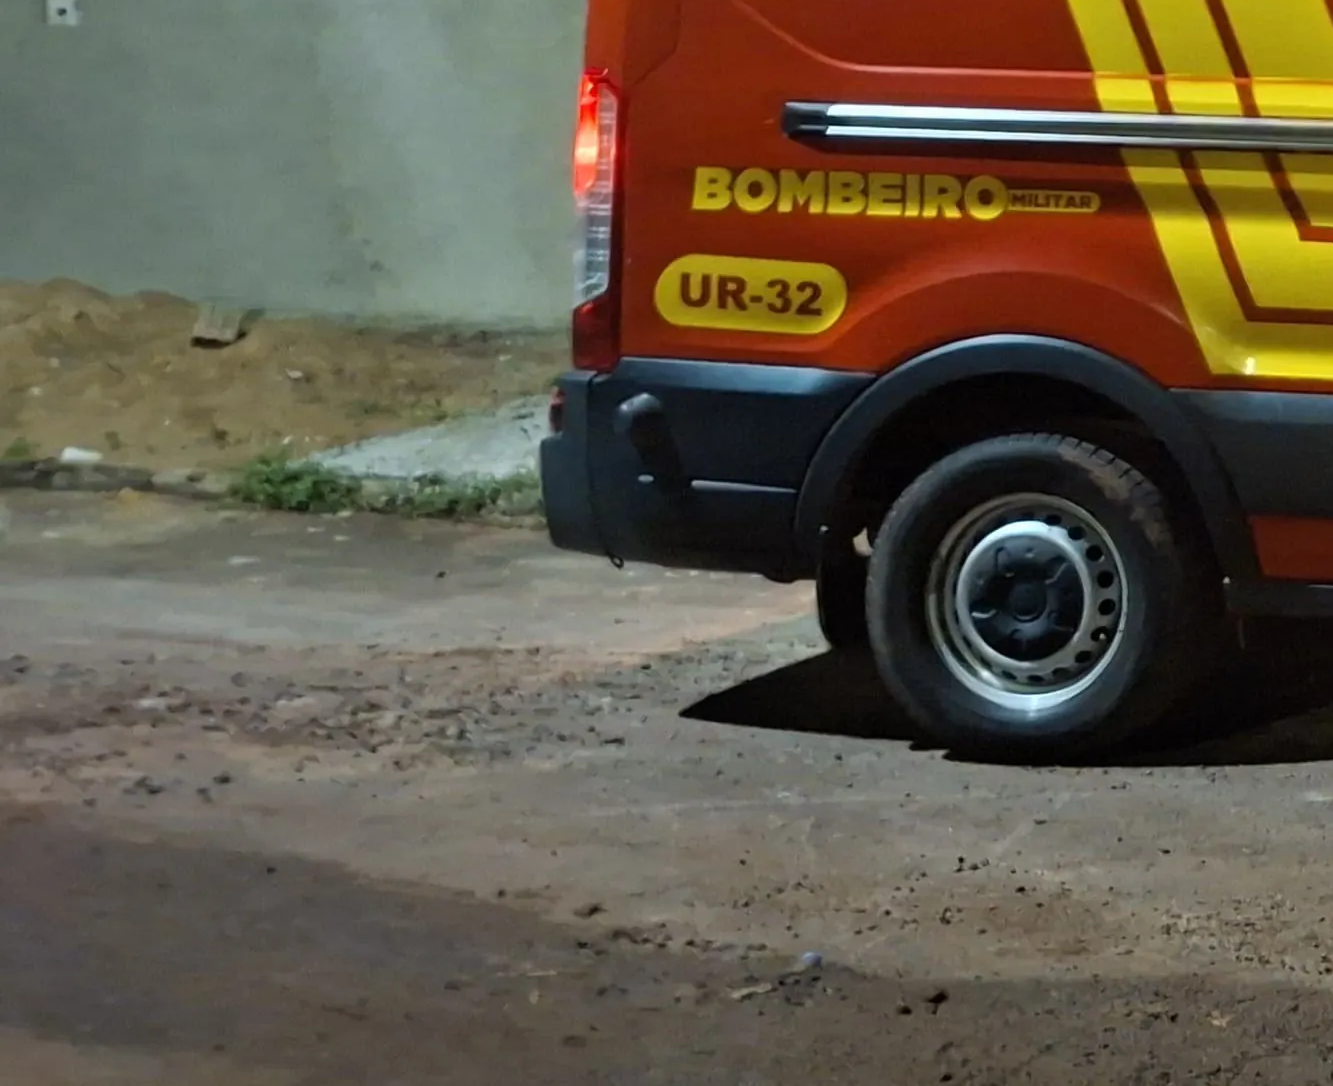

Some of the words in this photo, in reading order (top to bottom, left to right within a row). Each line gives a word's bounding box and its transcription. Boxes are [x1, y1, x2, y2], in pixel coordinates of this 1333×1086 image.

[692, 166, 1008, 220] BOMBEIRO
[1010, 193, 1092, 209] MILITAR
[679, 271, 823, 317] UR-32
